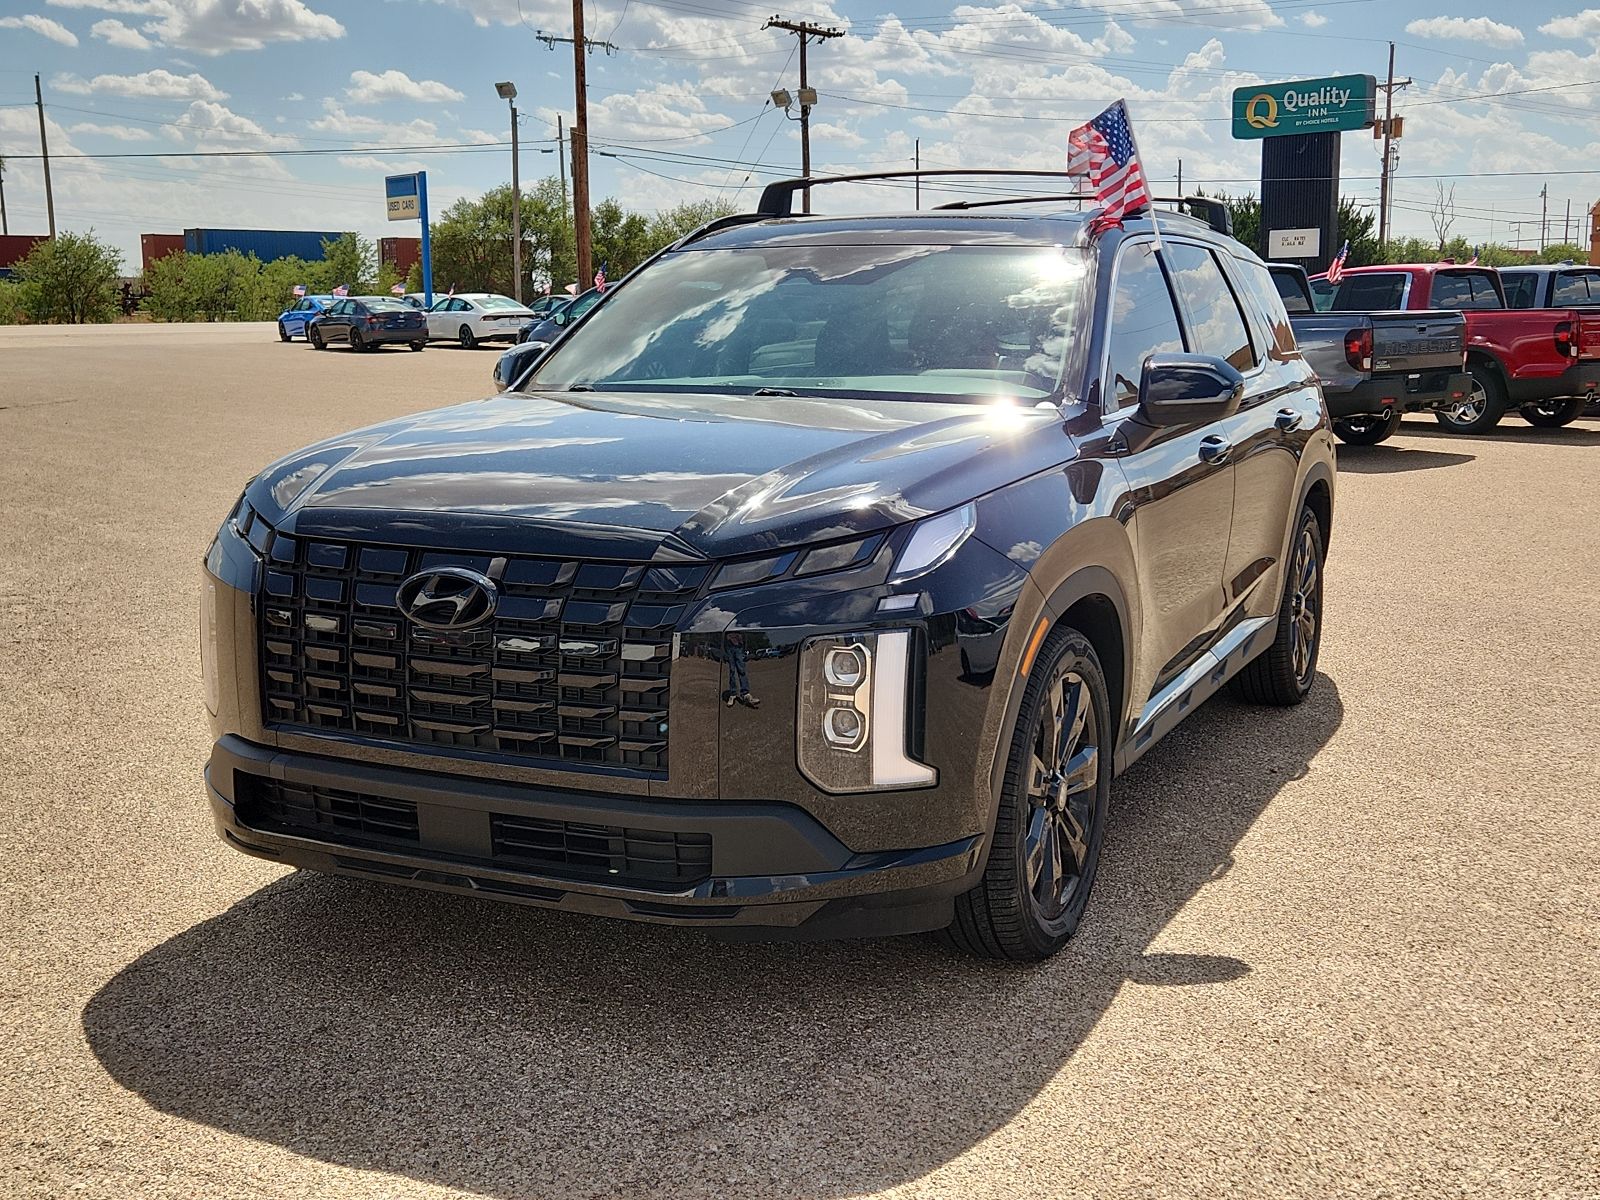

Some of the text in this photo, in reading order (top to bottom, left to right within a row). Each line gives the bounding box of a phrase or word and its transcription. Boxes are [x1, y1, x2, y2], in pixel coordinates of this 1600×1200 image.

[1283, 87, 1351, 112] Quality
[1246, 94, 1280, 129] Q
[1308, 108, 1328, 117] INN
[388, 200, 414, 211] USED CARS
